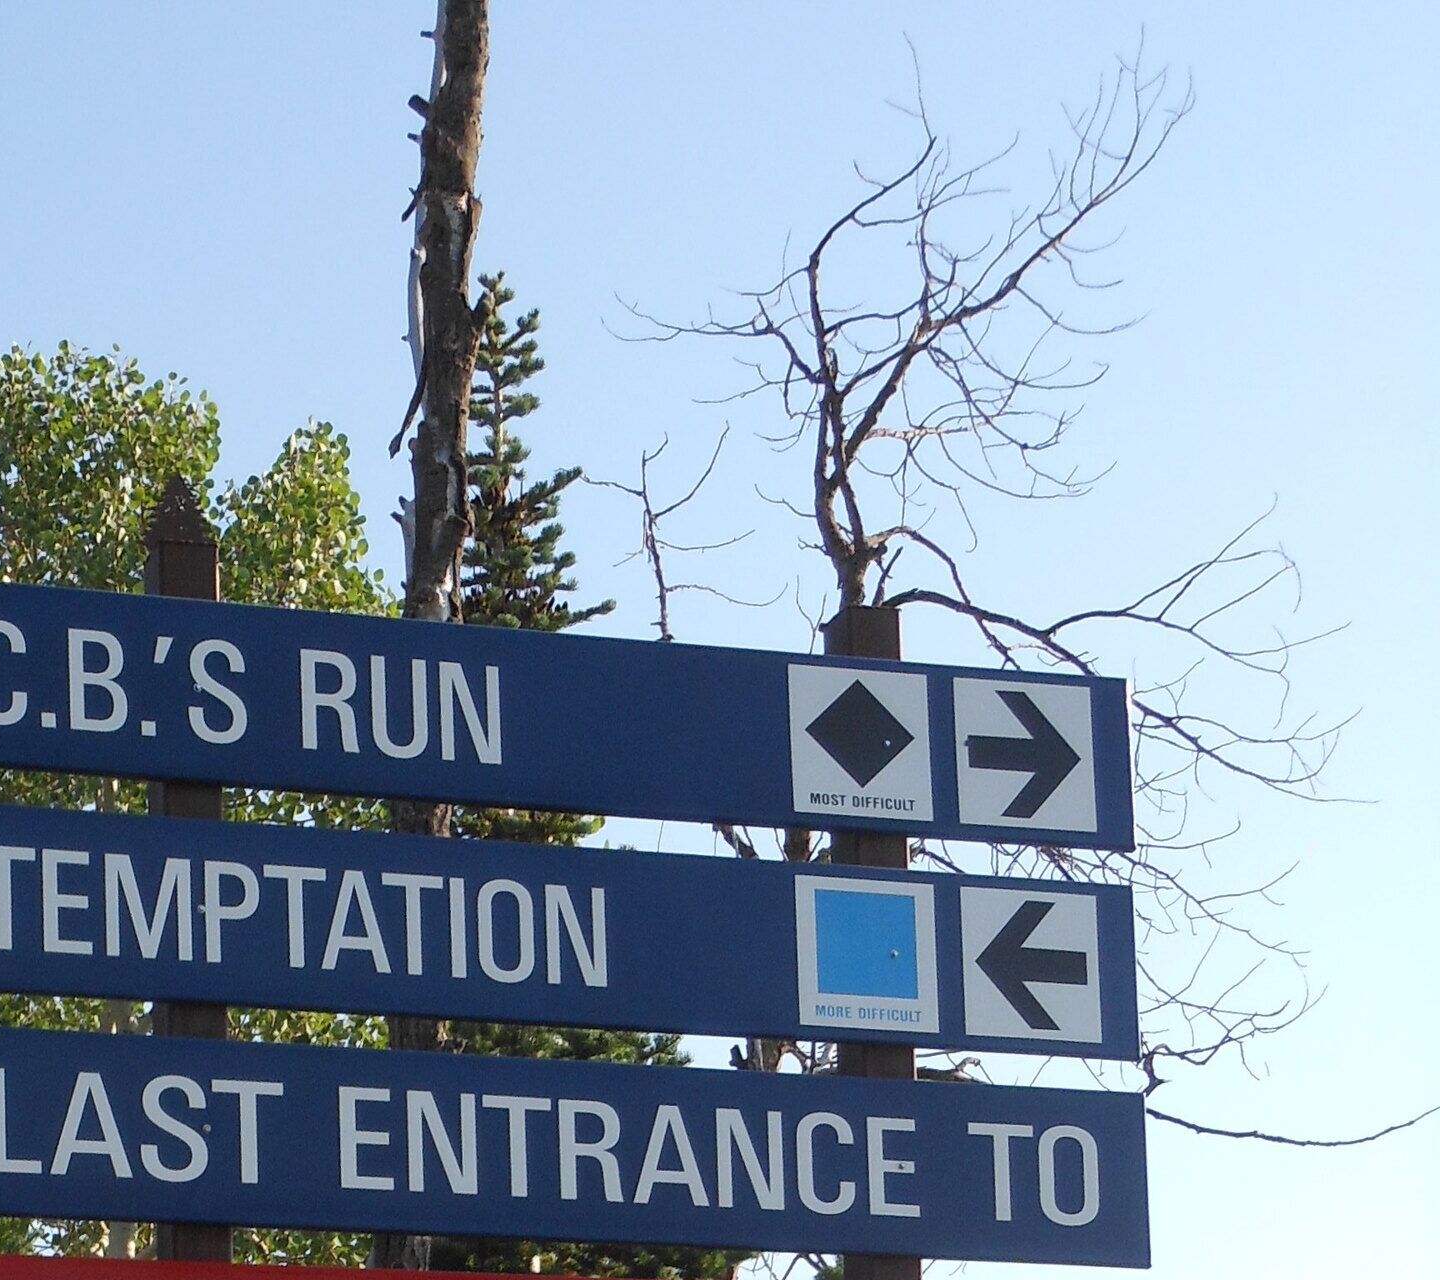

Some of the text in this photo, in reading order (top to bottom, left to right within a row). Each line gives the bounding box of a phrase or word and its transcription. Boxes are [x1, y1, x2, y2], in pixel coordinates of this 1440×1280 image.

[301, 649, 501, 764] RUN
[810, 792, 915, 812] MOST DIFFICULT
[815, 1004, 922, 1023] MORE DIFFICULT
[339, 1086, 920, 1217] ENTRANCE
[968, 1123, 1099, 1226] TO
